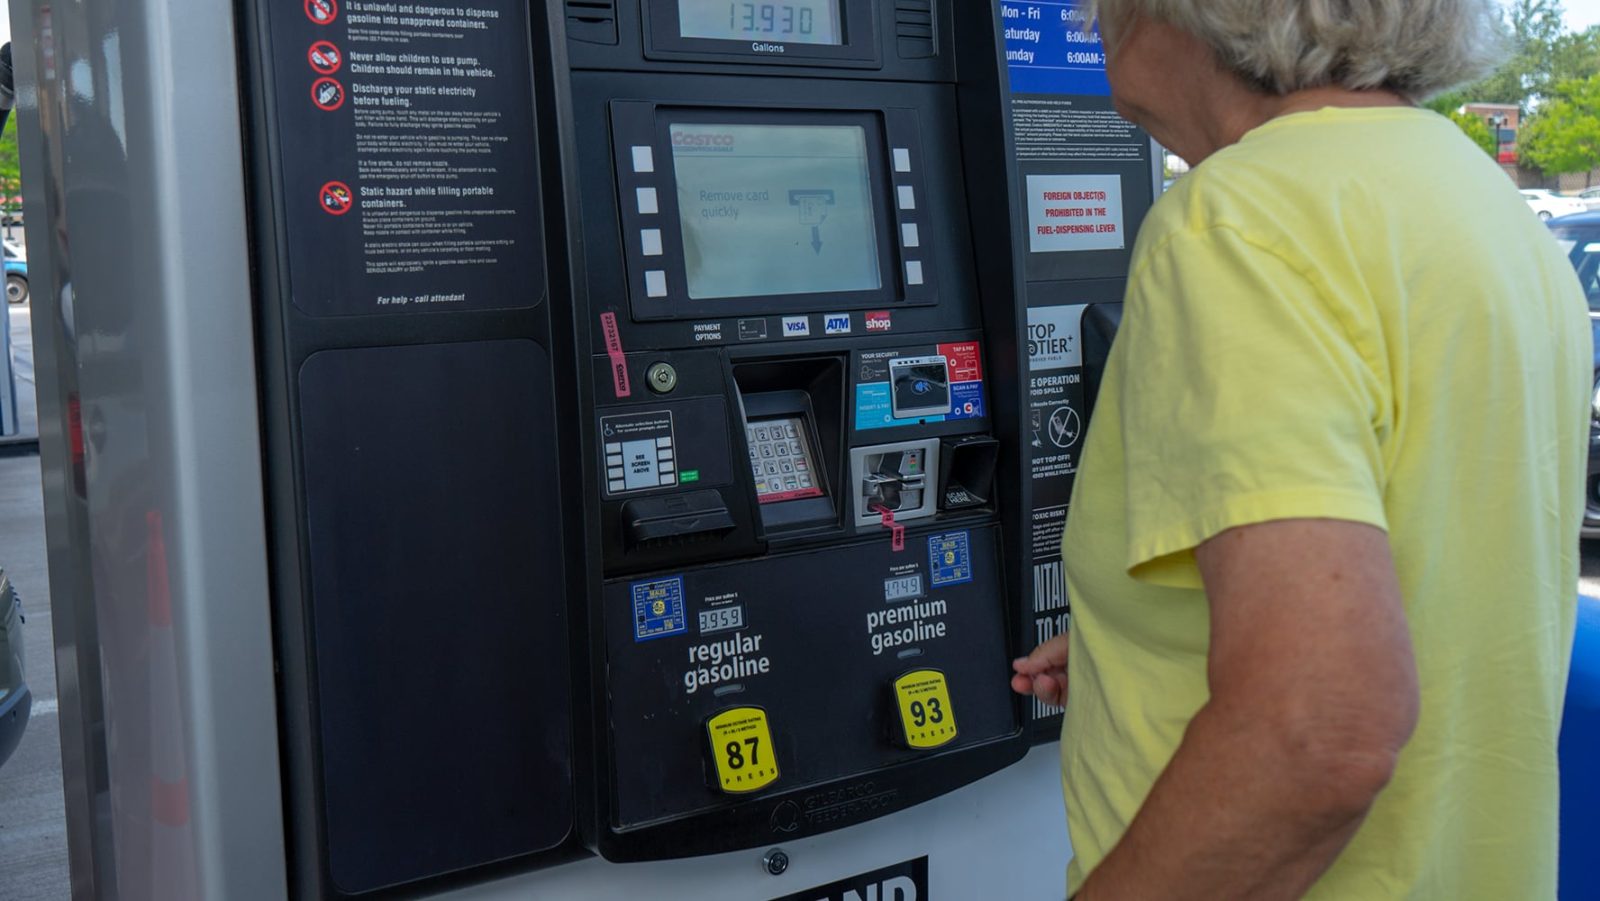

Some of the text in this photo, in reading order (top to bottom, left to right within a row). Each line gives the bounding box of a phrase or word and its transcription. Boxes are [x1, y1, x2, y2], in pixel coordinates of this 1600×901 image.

[346, 1, 498, 18] It is unlawful and dangerous to dispense
[1028, 7, 1040, 19] Fri
[347, 14, 488, 29] gasoline into unapproved containers.
[730, 4, 812, 34] 13.930
[1004, 28, 1040, 43] aturday
[1066, 31, 1101, 43] 6:00AM-
[752, 42, 784, 52] Gallons
[350, 52, 373, 61] Never
[375, 53, 397, 62] allow
[399, 54, 430, 64] children
[431, 56, 439, 64] to
[456, 57, 480, 66] pump.
[1006, 49, 1034, 64] unday
[351, 64, 495, 78] Children should remain in the vehicle.
[353, 84, 476, 98] Discharge your static electricity
[354, 96, 412, 107] before fueling.
[361, 186, 494, 197] Static hazard while filling portable
[700, 190, 769, 201] Remove card
[1044, 191, 1106, 201] FOREIGN OBJECT(S)
[361, 199, 407, 208] containers.
[701, 206, 738, 220] quickly
[1045, 208, 1106, 217] PROHIBITED IN THE
[1037, 224, 1116, 234] FUEL-DISPENSING LEVER
[377, 296, 390, 304] For
[391, 295, 408, 304] help
[415, 295, 429, 303] call
[430, 294, 465, 302] attendant
[694, 323, 721, 332] PAYMENT
[786, 322, 806, 331] VISA
[827, 318, 849, 330] ATM
[866, 318, 890, 330] shop
[695, 333, 722, 341] OPTIONS
[1028, 324, 1055, 339] TOP
[1037, 374, 1080, 387] OPERATION
[1044, 386, 1063, 395] SPILLS
[701, 609, 738, 630] 3.959
[867, 599, 947, 634] premium
[871, 620, 946, 655] gasoline
[689, 632, 762, 664] regular
[684, 655, 770, 694] gasoline
[910, 698, 943, 727] 93
[726, 736, 758, 769] 87
